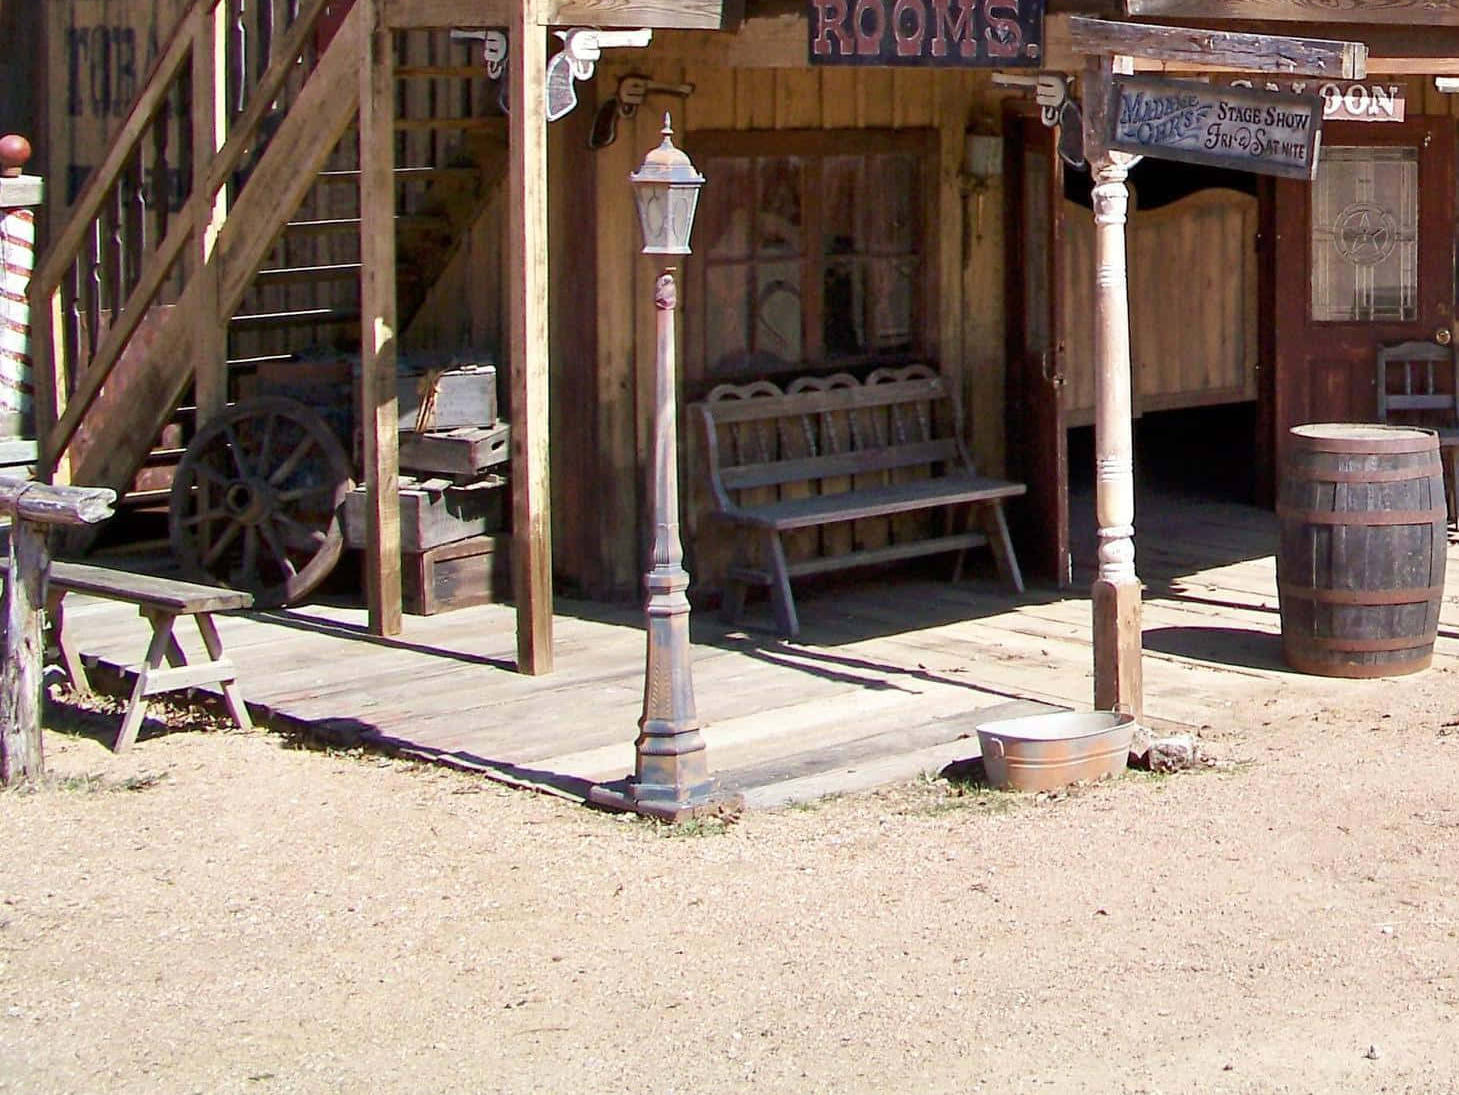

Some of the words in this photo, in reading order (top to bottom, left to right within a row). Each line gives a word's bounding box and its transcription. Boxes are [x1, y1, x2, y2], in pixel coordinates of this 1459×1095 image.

[1217, 101, 1261, 125] STAGE
[1265, 106, 1310, 131] SHOW
[1230, 80, 1398, 116] OON
[1204, 123, 1233, 150] FRI
[1250, 128, 1280, 156] SAT
[1281, 139, 1305, 160] NITE
